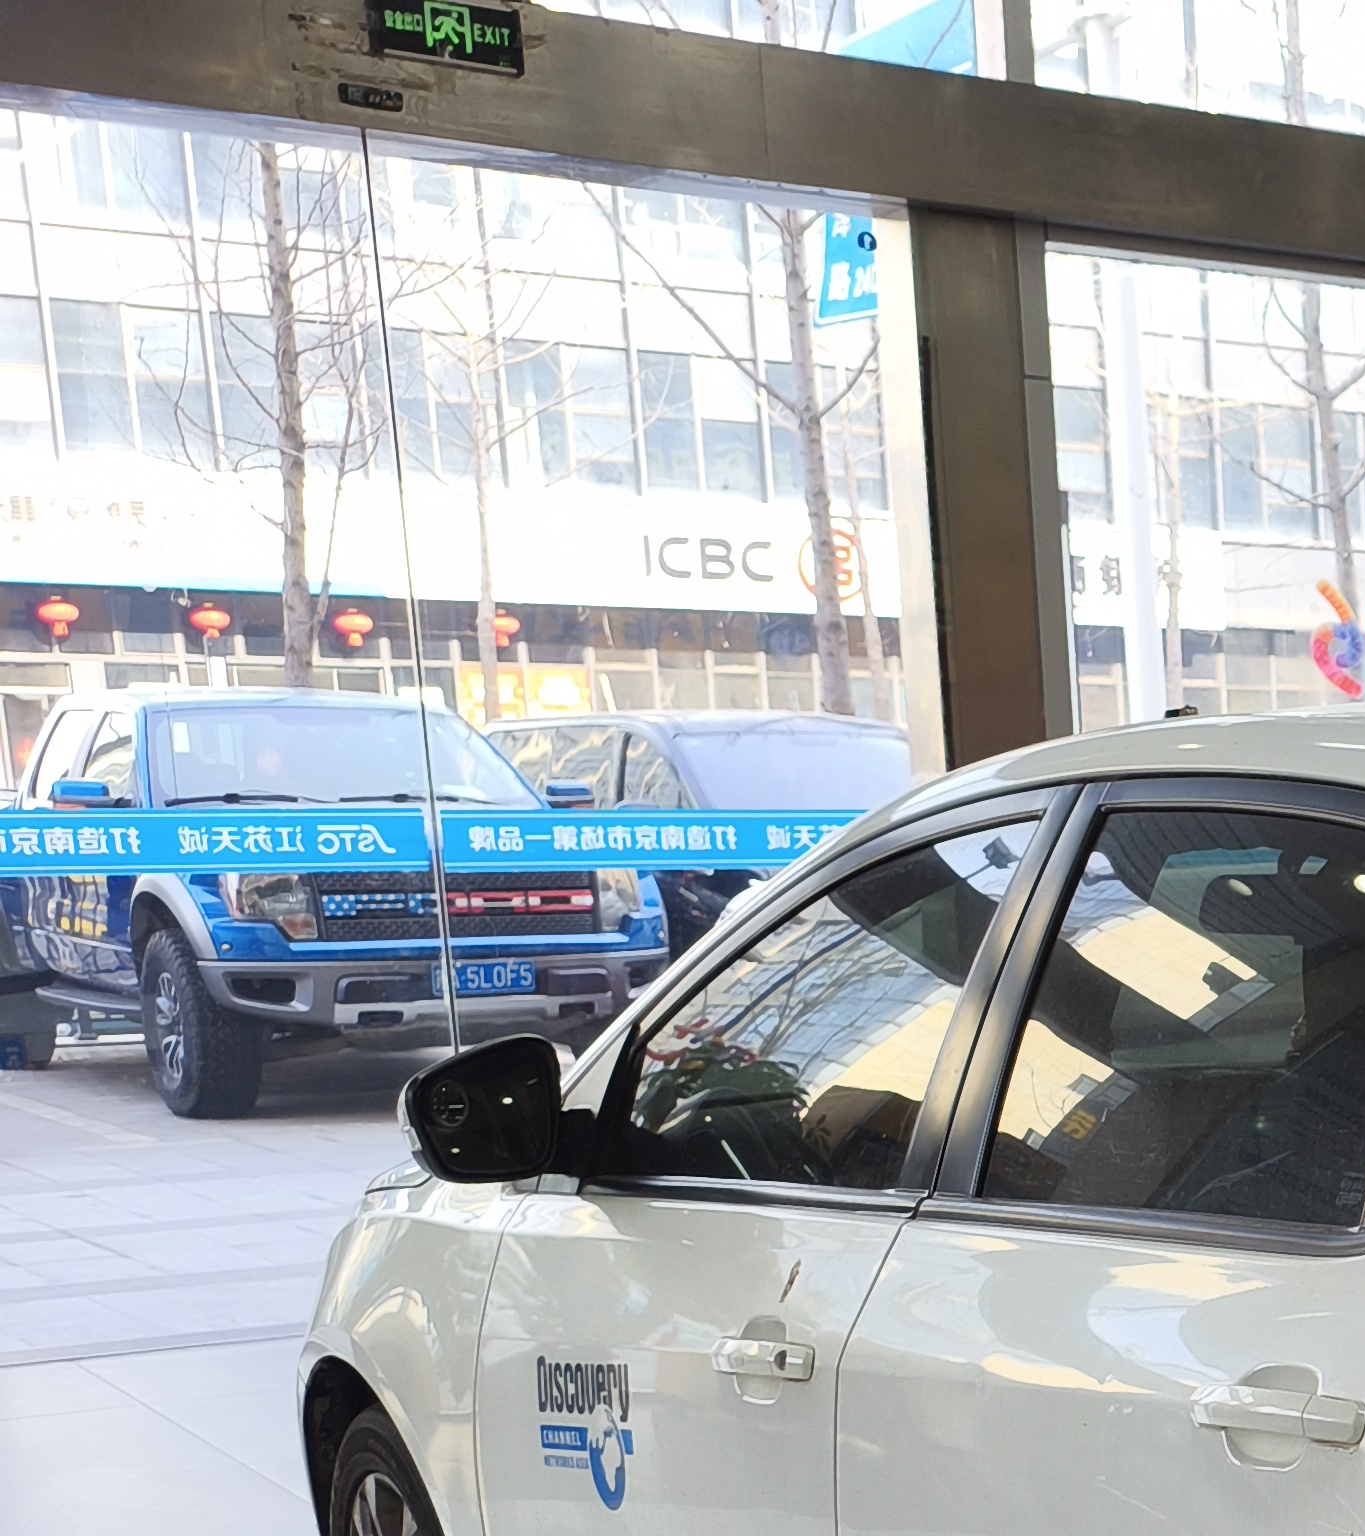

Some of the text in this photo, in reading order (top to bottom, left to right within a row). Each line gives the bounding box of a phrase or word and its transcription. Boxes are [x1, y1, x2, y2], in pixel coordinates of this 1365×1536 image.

[473, 23, 511, 47] EXIT
[643, 535, 774, 583] ICBC
[543, 1429, 582, 1447] CHANNEL
